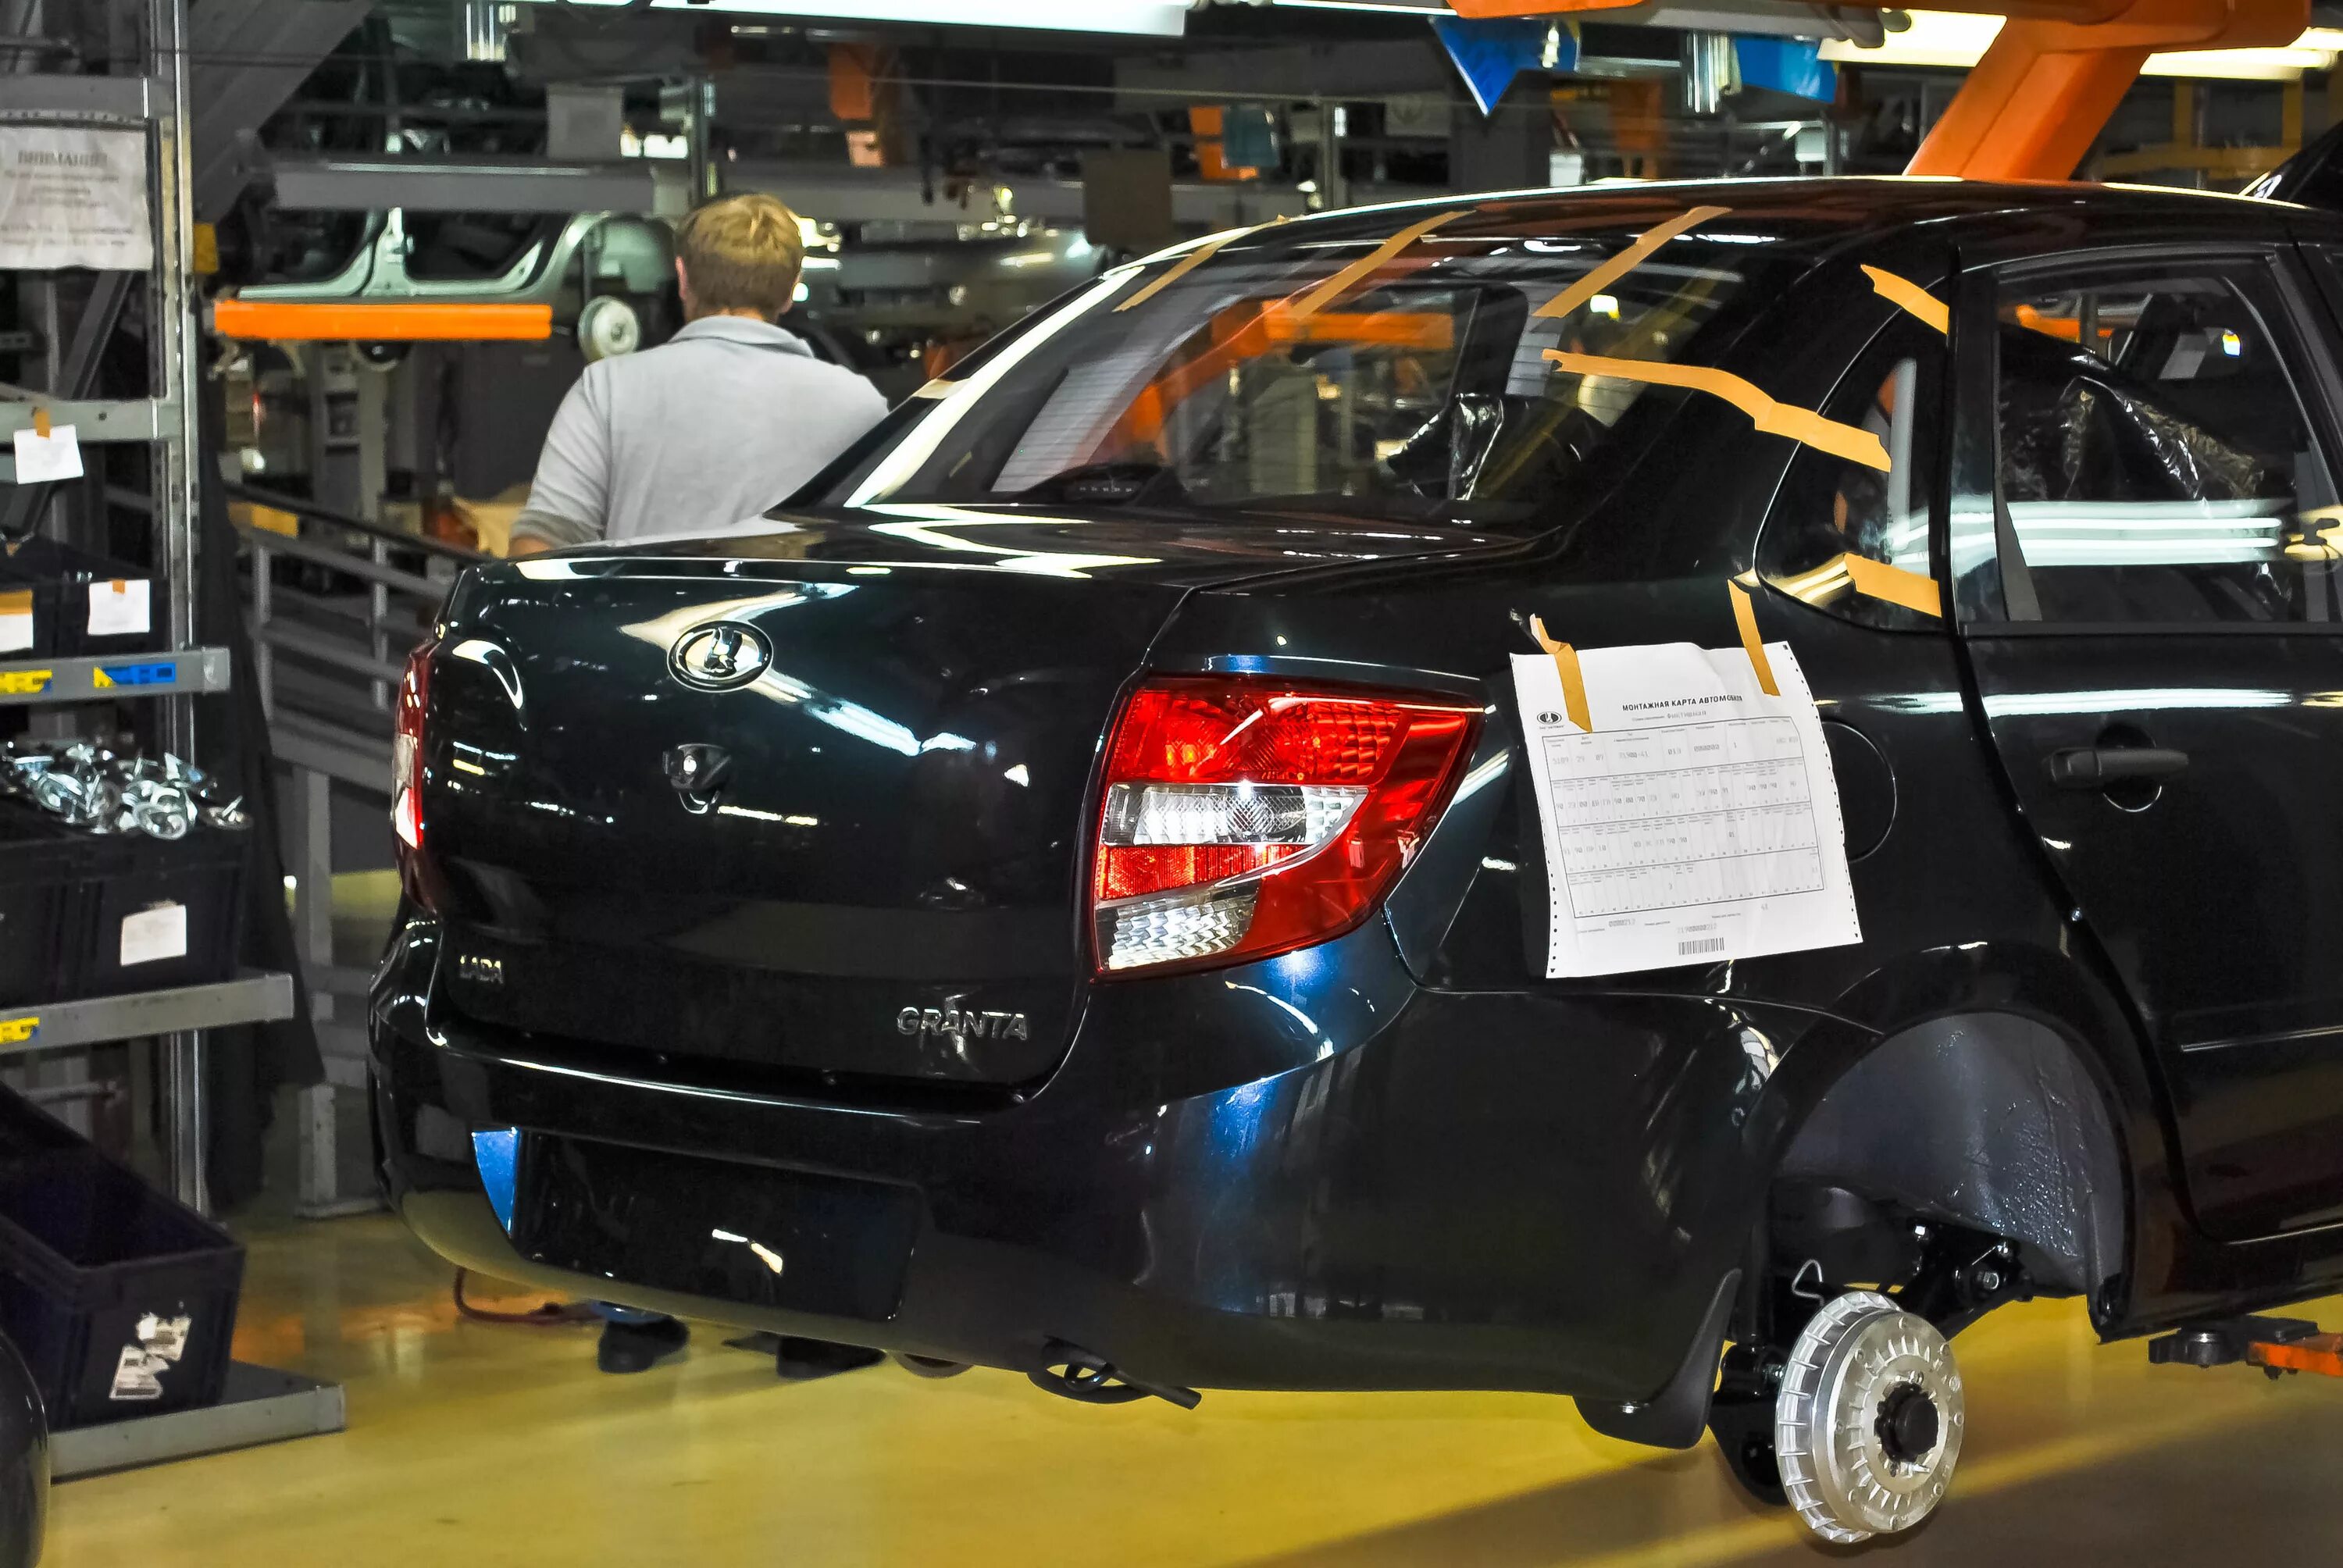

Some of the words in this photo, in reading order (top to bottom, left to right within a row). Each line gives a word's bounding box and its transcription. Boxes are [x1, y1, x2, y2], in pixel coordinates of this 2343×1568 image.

[1622, 700, 1670, 711] МОНТАЖНАЯ
[1671, 697, 1697, 707] КАРТА
[458, 954, 504, 985] LADA
[897, 1007, 1028, 1041] GRANTA
